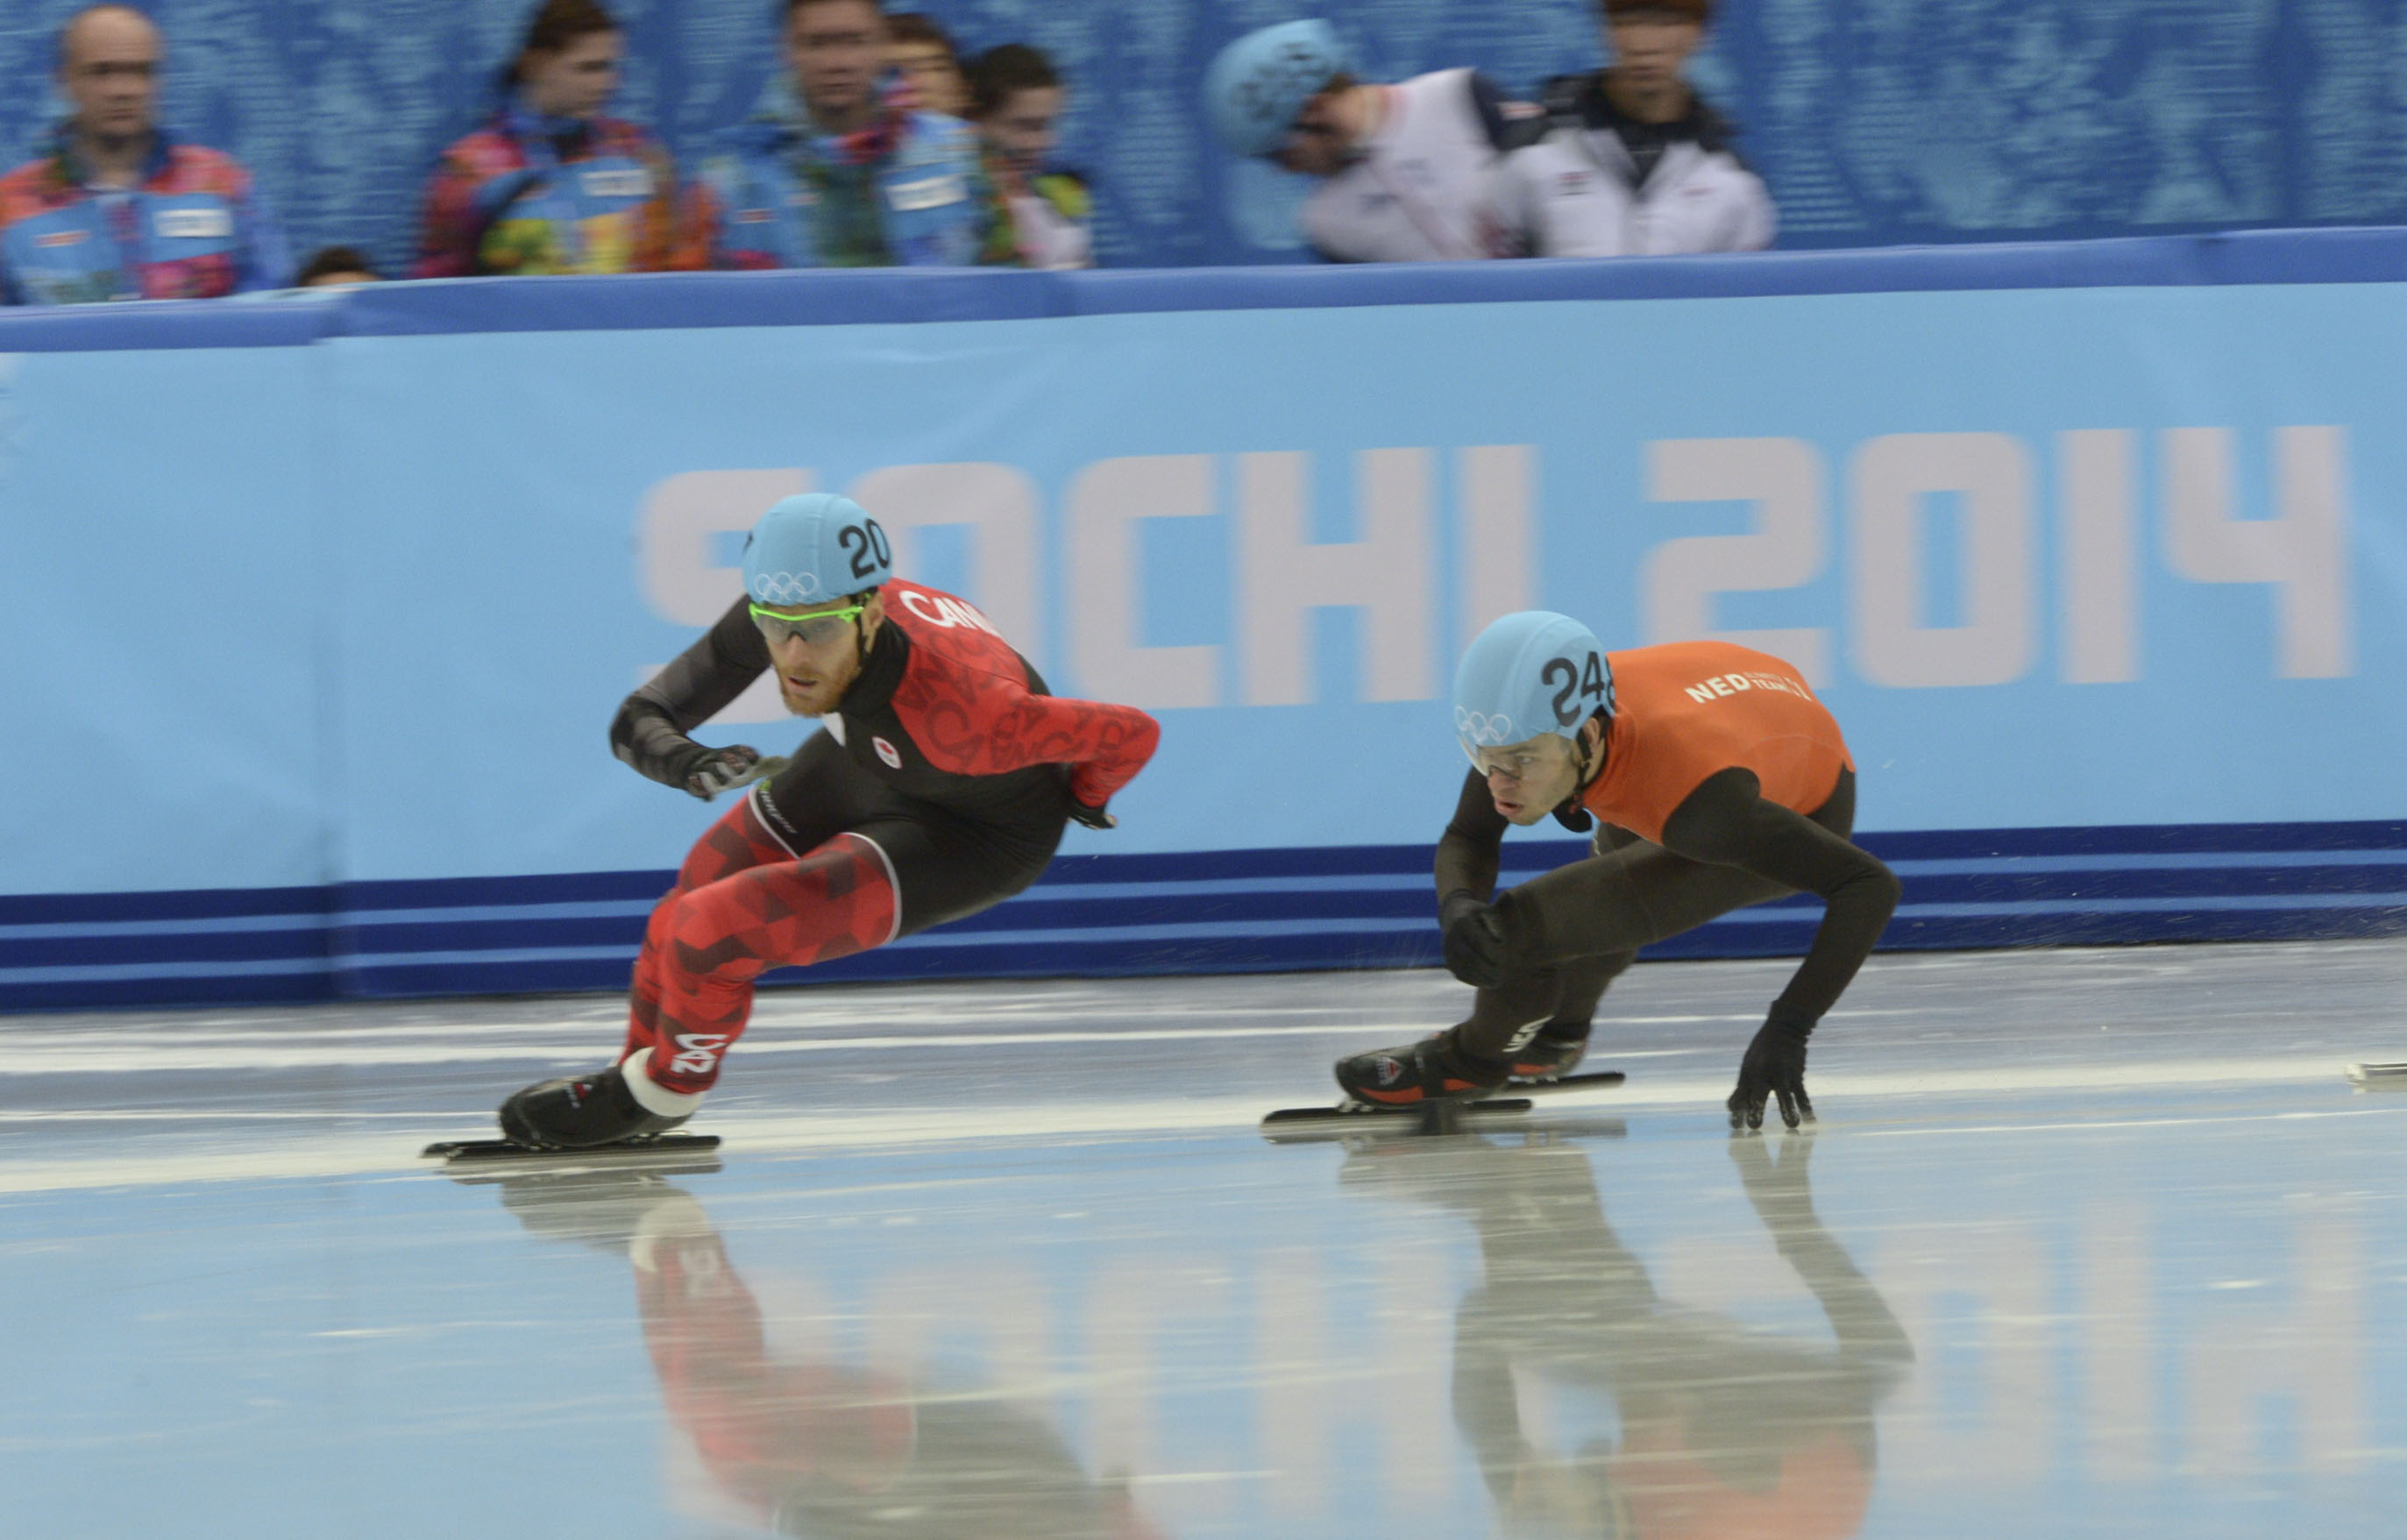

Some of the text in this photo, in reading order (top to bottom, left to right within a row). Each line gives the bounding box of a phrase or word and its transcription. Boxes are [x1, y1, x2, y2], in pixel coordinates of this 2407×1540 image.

[839, 518, 891, 579] 20
[1642, 424, 2353, 691] 2014
[1684, 673, 1751, 703] NED
